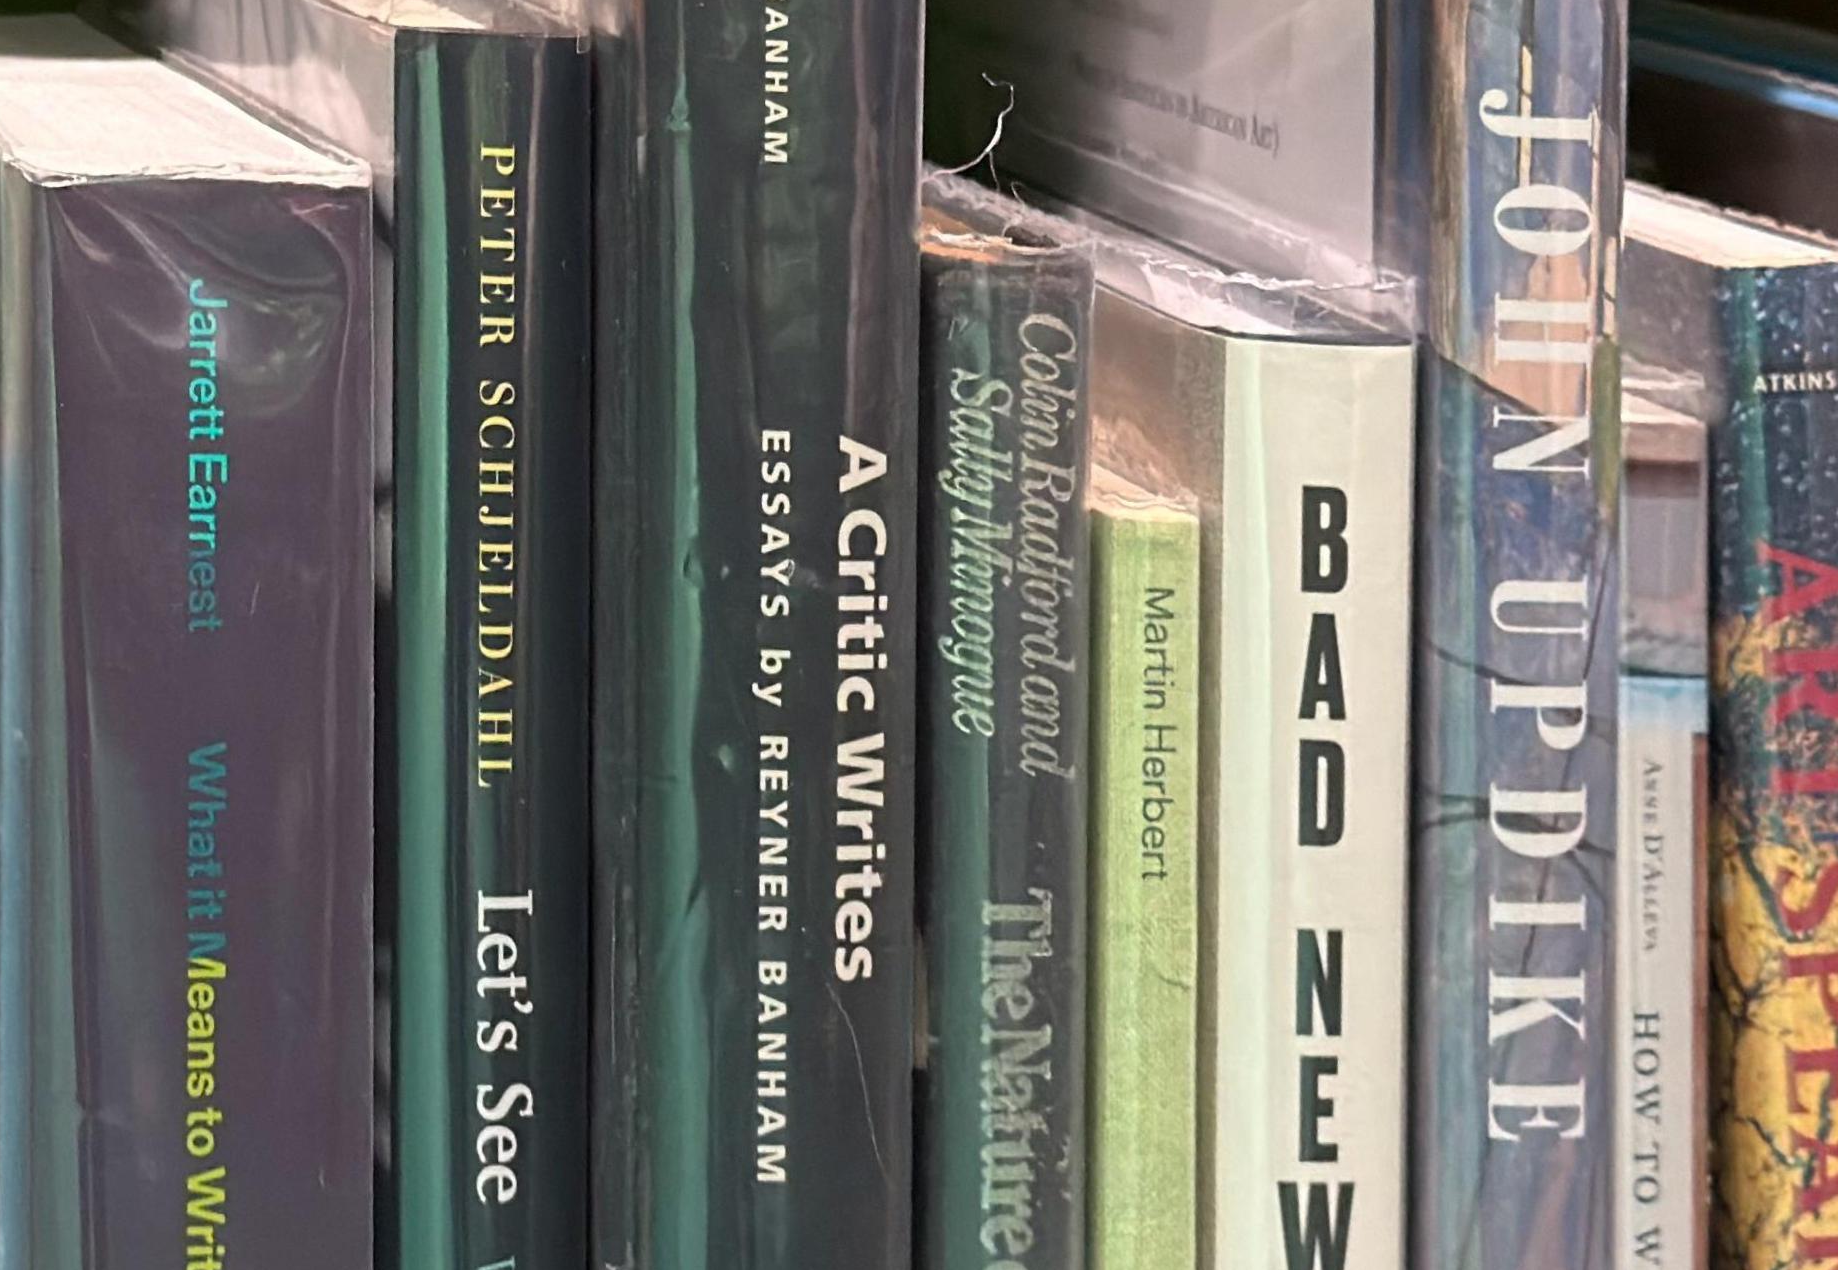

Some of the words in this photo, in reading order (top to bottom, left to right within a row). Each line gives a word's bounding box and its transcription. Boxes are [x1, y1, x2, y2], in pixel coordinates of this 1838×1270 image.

[477, 143, 517, 348] PETER
[1476, 87, 1598, 481] JOHN
[185, 279, 229, 440] Jarrett
[1754, 369, 1837, 393] ATKINS
[186, 450, 228, 630] Earnest
[476, 379, 517, 787] SCHJELDAHL
[760, 429, 791, 618] ESSAYS
[835, 510, 888, 712] Critic
[1141, 586, 1175, 709] Martin
[1297, 484, 1350, 846] BAD
[186, 740, 227, 878] What
[757, 734, 790, 931] REYNER
[834, 731, 887, 982] Writes
[1140, 724, 1177, 880] Herbert
[1485, 578, 1590, 1142] UPDIKE
[185, 930, 227, 1094] Means
[756, 958, 789, 1183] BANHAM
[476, 1082, 535, 1203] See
